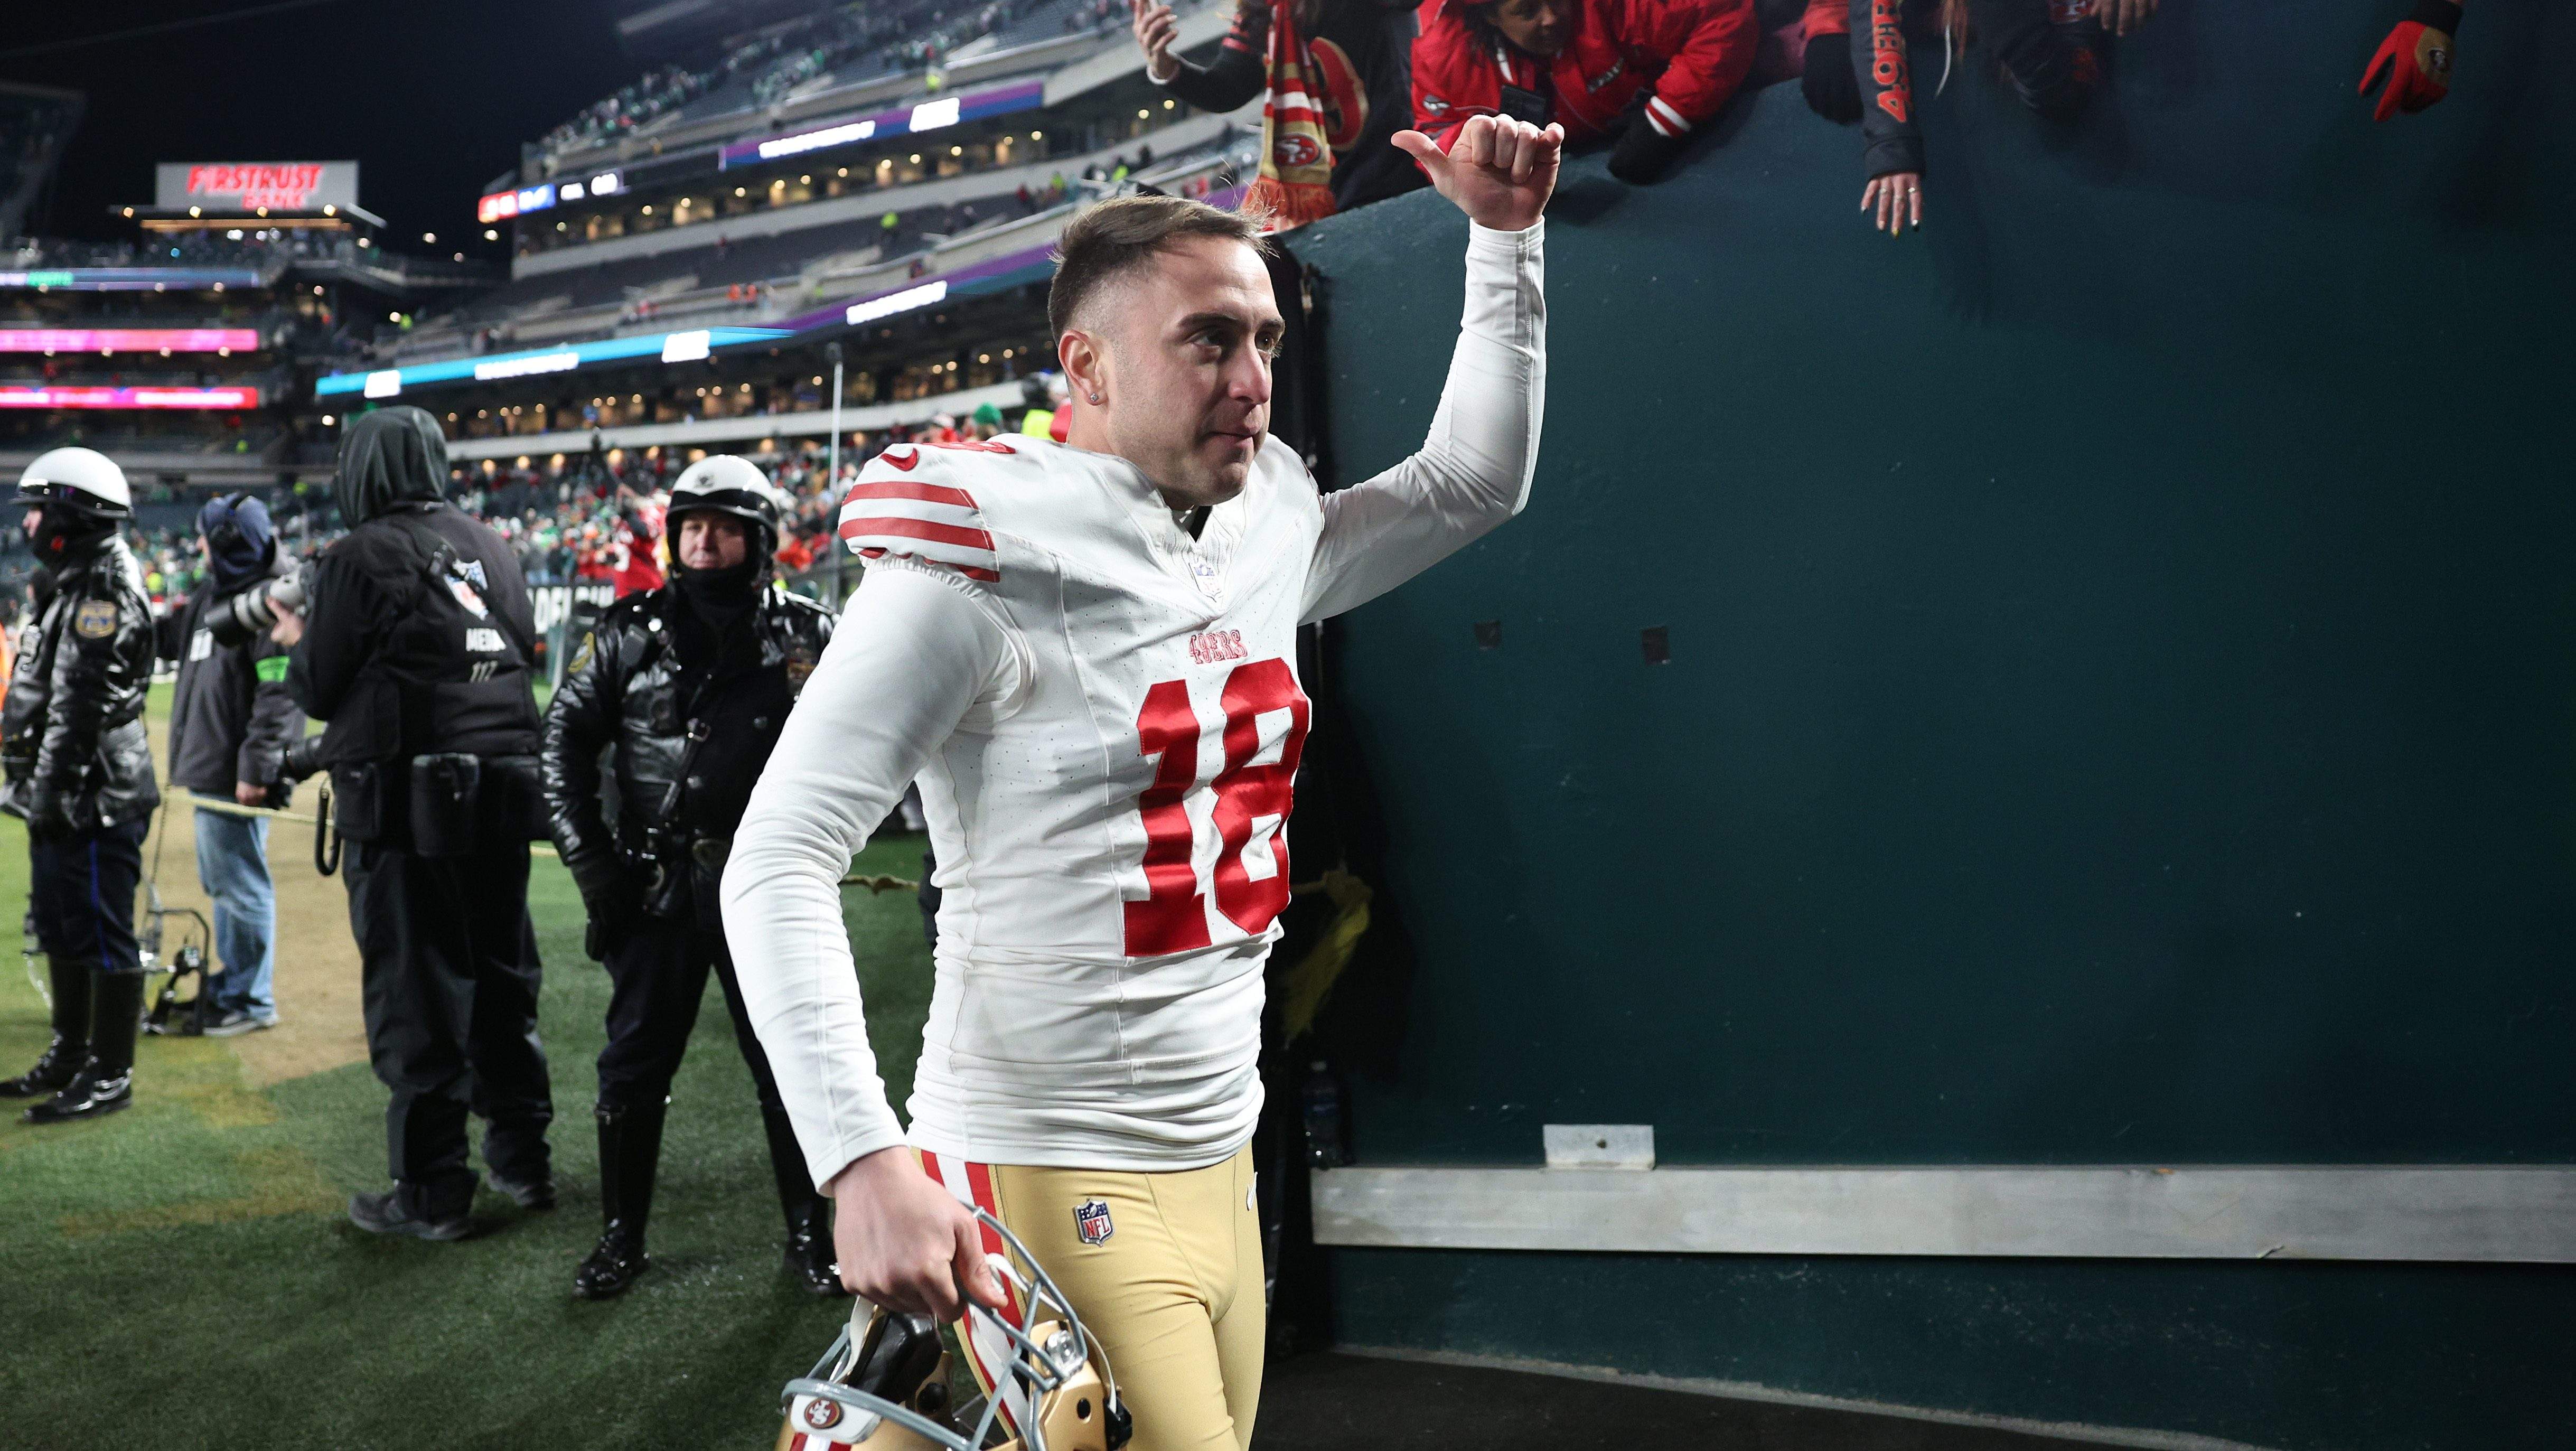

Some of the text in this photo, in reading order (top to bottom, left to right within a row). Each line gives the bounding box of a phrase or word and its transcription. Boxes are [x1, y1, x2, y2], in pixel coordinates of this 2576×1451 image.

[1189, 630, 1248, 664] 49ERS
[1125, 657, 1312, 957] 18
[1083, 1218, 1110, 1238] NFL
